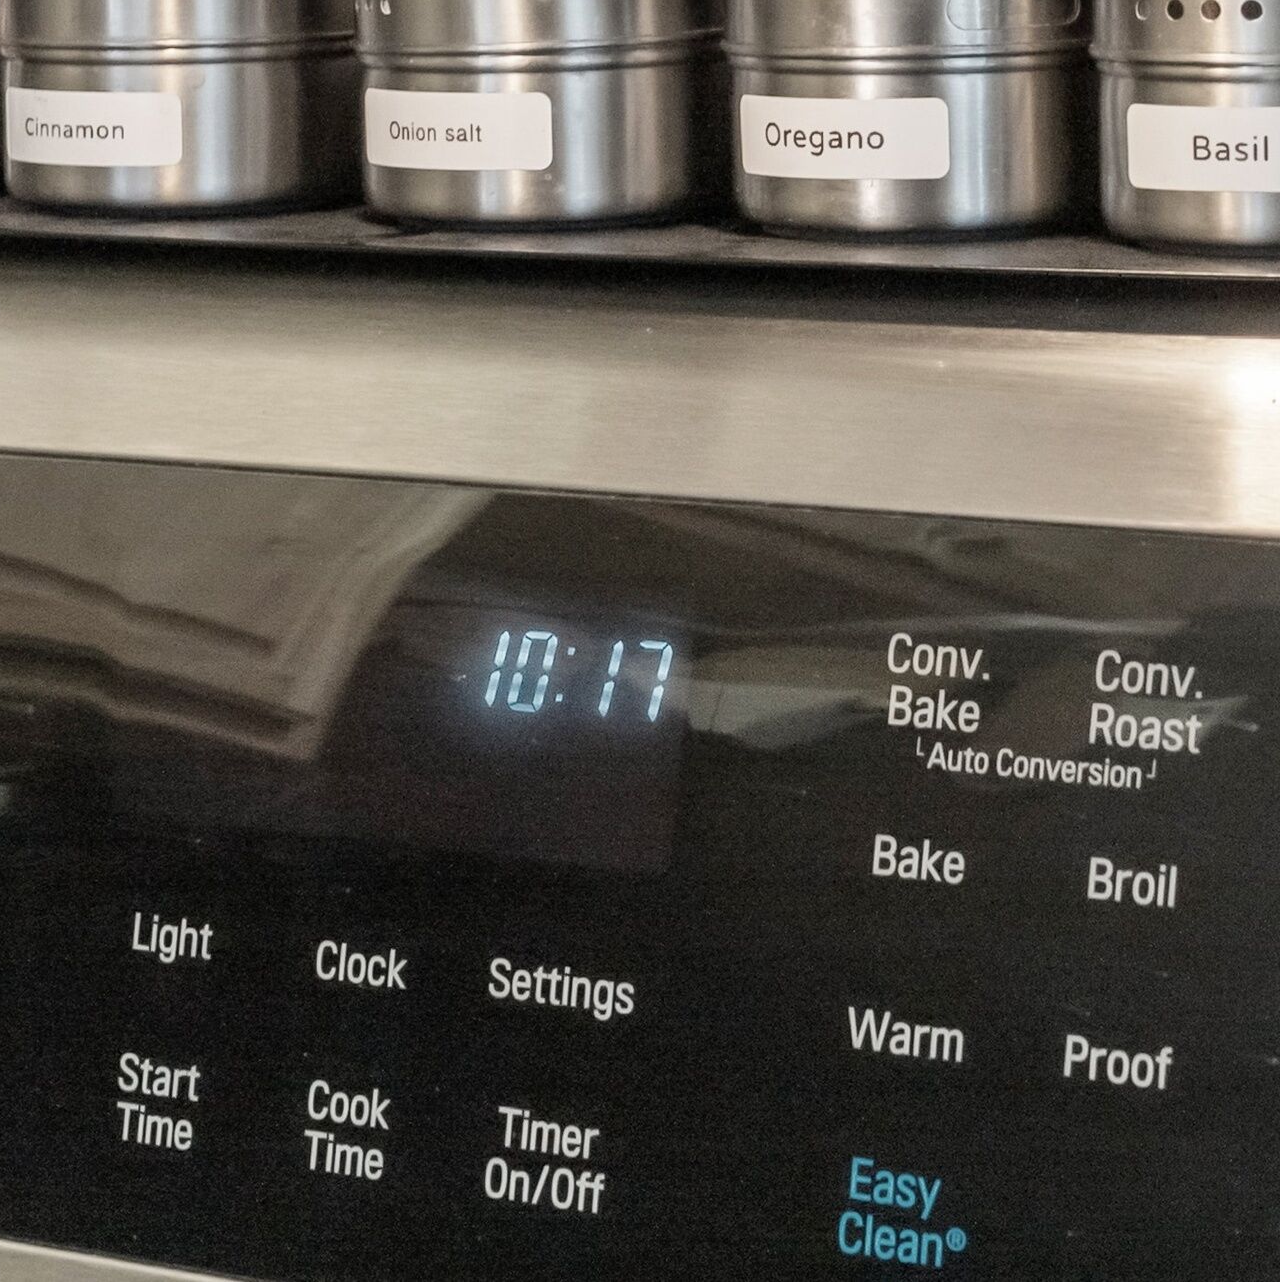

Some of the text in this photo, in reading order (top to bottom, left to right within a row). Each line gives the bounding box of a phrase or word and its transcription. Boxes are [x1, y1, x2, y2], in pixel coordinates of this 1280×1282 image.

[24, 116, 125, 140] Cinnamon
[388, 120, 482, 143] Onion salt
[764, 121, 885, 157] Oregano
[1192, 134, 1269, 162] Basil
[484, 630, 674, 722] 10:17
[887, 632, 990, 681] Conv.
[1095, 649, 1203, 700] Conv.
[887, 684, 981, 733] Bake
[1089, 702, 1204, 754] Roast
[926, 741, 1143, 790] Auto Conversion
[872, 833, 965, 885] Bake
[1087, 856, 1178, 908] Broil
[132, 912, 214, 964] Light
[315, 939, 408, 990] Clock
[488, 957, 635, 1021] Settings
[848, 1006, 964, 1063] Warm
[117, 1052, 201, 1102] Start
[1063, 1034, 1173, 1090] Proof
[116, 1101, 194, 1151] Time
[307, 1079, 391, 1131] Cook
[304, 1129, 385, 1181] Time
[498, 1106, 600, 1161] Timer
[484, 1157, 606, 1214] On/Off
[849, 1156, 942, 1221] Easy
